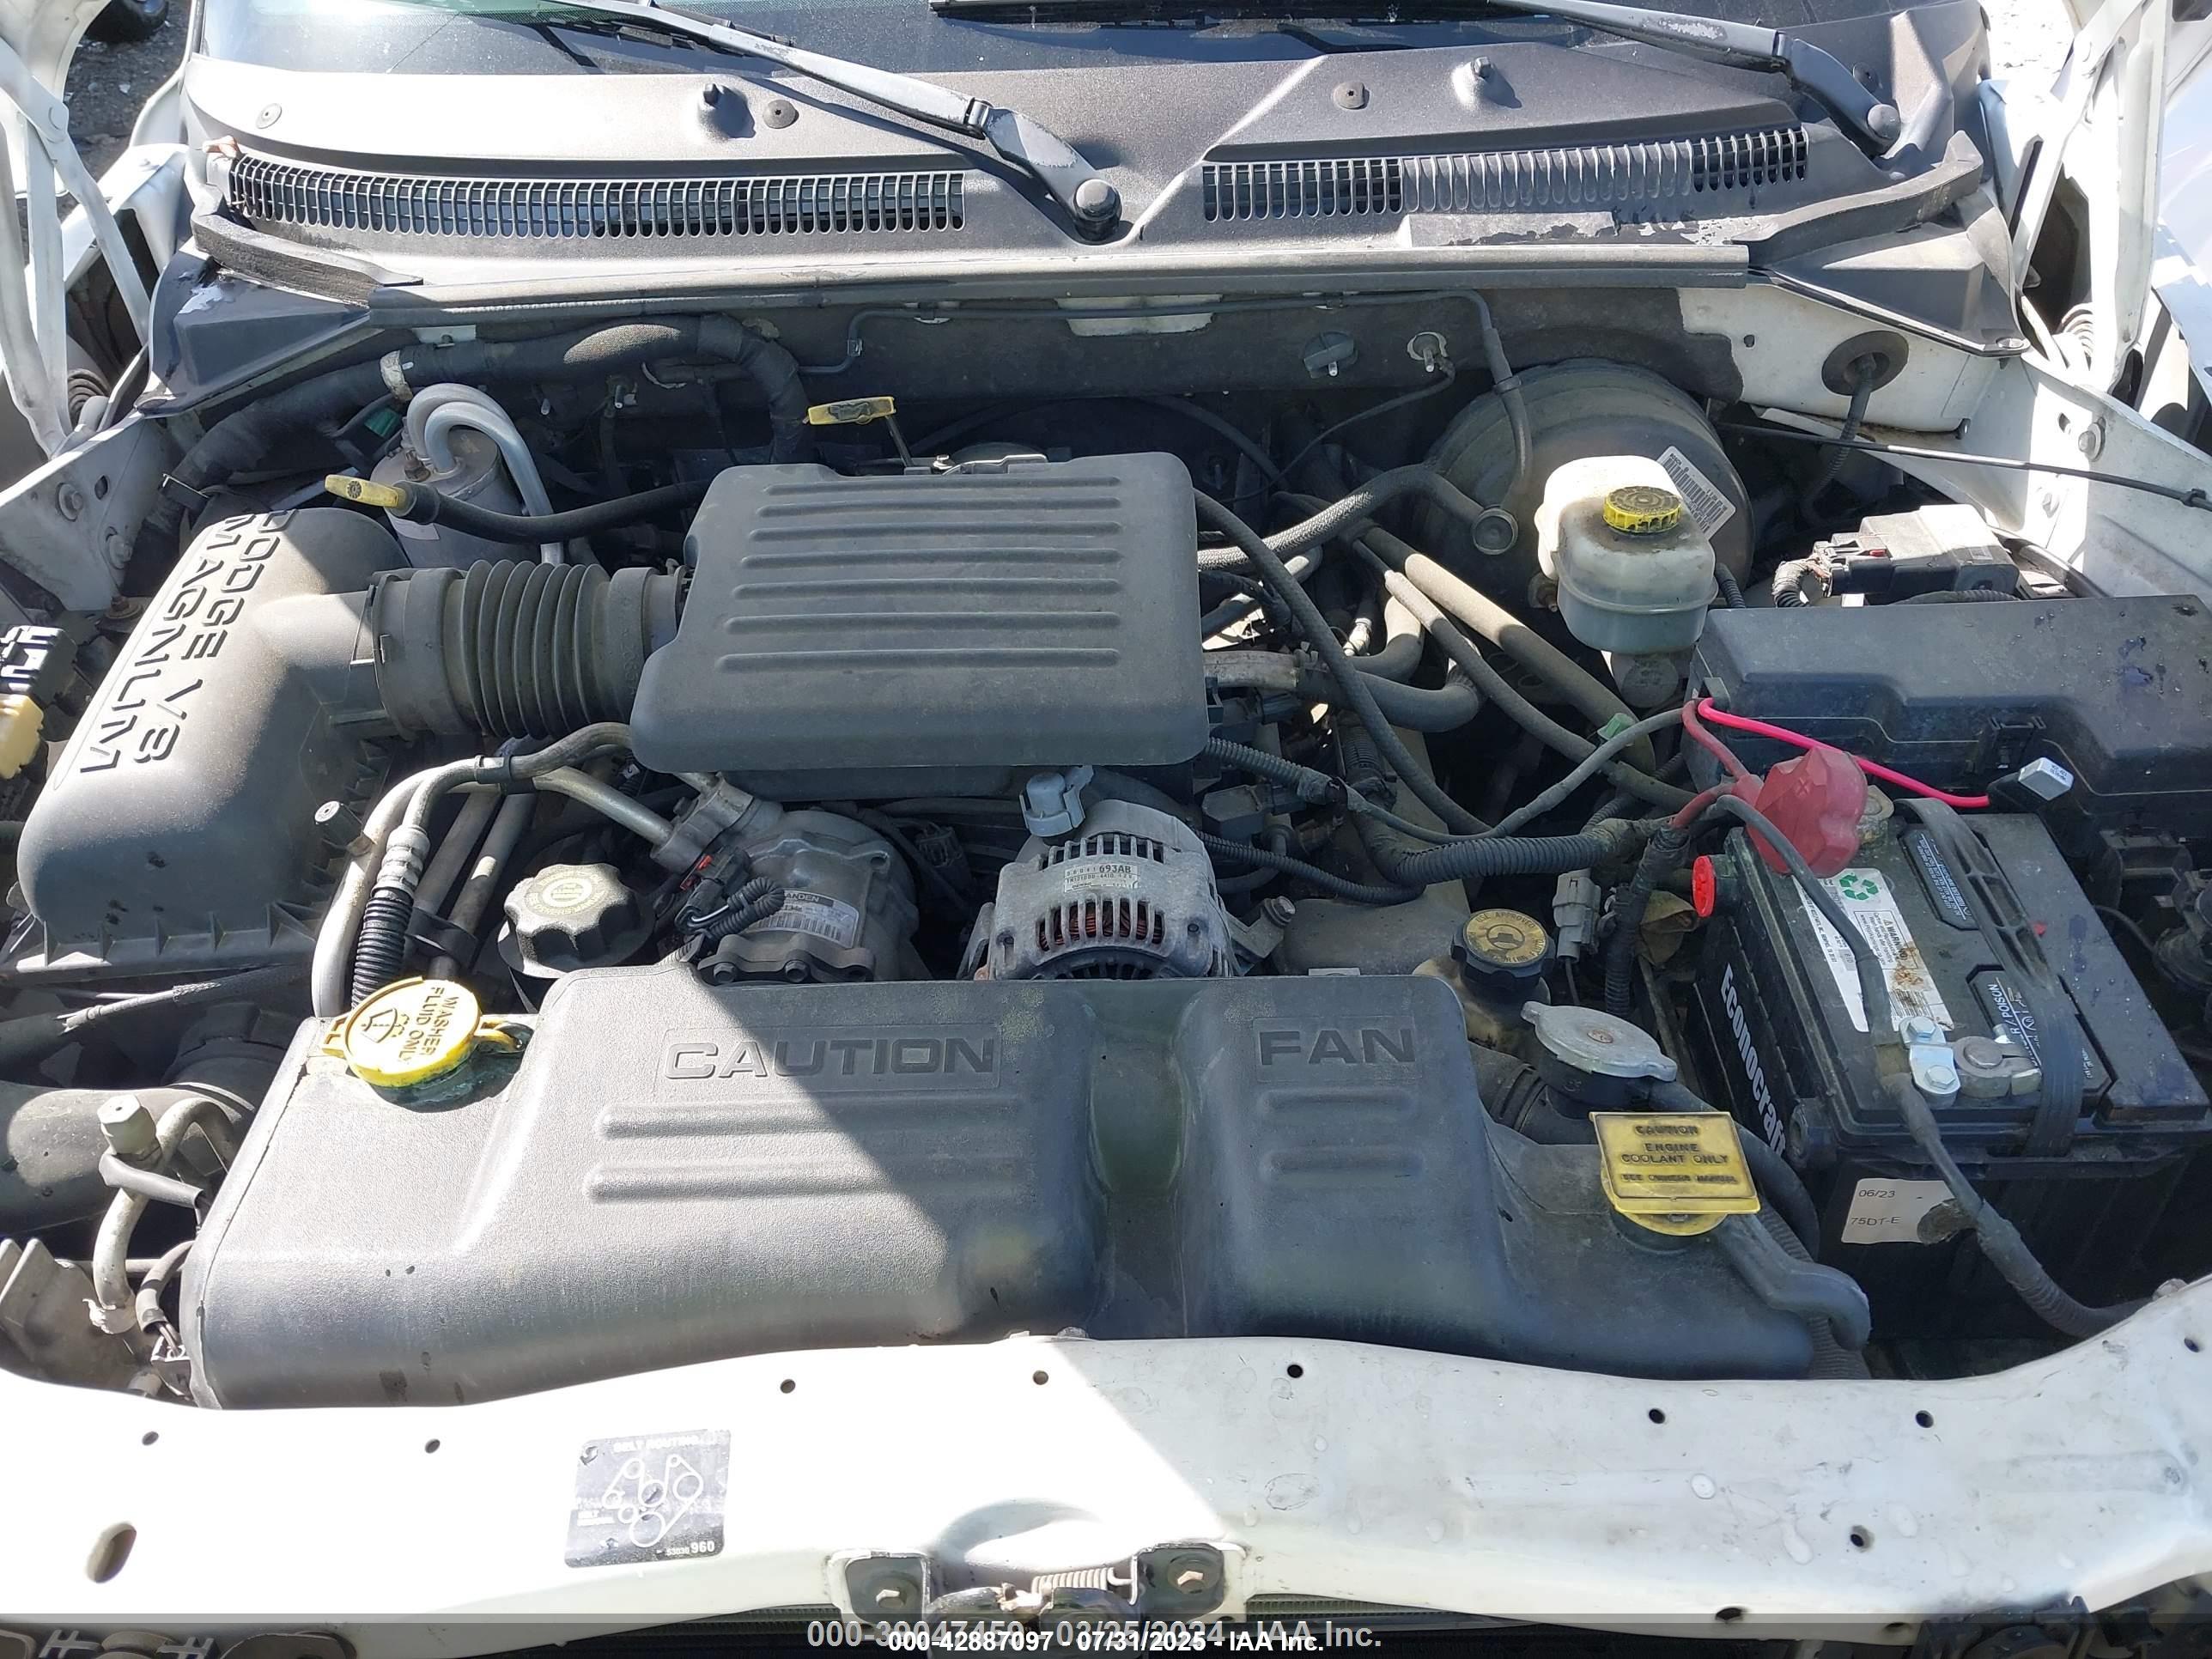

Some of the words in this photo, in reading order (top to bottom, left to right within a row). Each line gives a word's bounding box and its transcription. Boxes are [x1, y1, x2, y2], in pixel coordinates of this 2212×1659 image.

[181, 508, 298, 660] DODGE
[80, 513, 258, 774] MAGNUM
[135, 678, 204, 764] V8
[785, 892, 820, 902] ANDEN
[1476, 913, 1491, 923] USE
[1495, 912, 1535, 928] APPROVED
[1887, 926, 1908, 960] WARNING
[416, 986, 445, 1025] FLUID
[1987, 984, 2015, 1019] POISON
[421, 995, 460, 1056] WASHER
[398, 1029, 425, 1062] ONLY
[663, 1037, 994, 1080] CAUTION
[1258, 1027, 1417, 1067] FAN
[1719, 963, 1787, 1158] Econocraft
[1635, 1125, 1699, 1135] CAUTION
[1620, 1153, 1686, 1164] COOLANT
[1692, 1154, 1729, 1164] ONLY
[1644, 1143, 1700, 1153] ENGINE
[1620, 1174, 1644, 1183] SEE
[1695, 1174, 1738, 1184] MANUAL
[1858, 1189, 1896, 1199] 06/23
[1850, 1216, 1902, 1226] 75DT-E
[690, 1540, 716, 1554] 960
